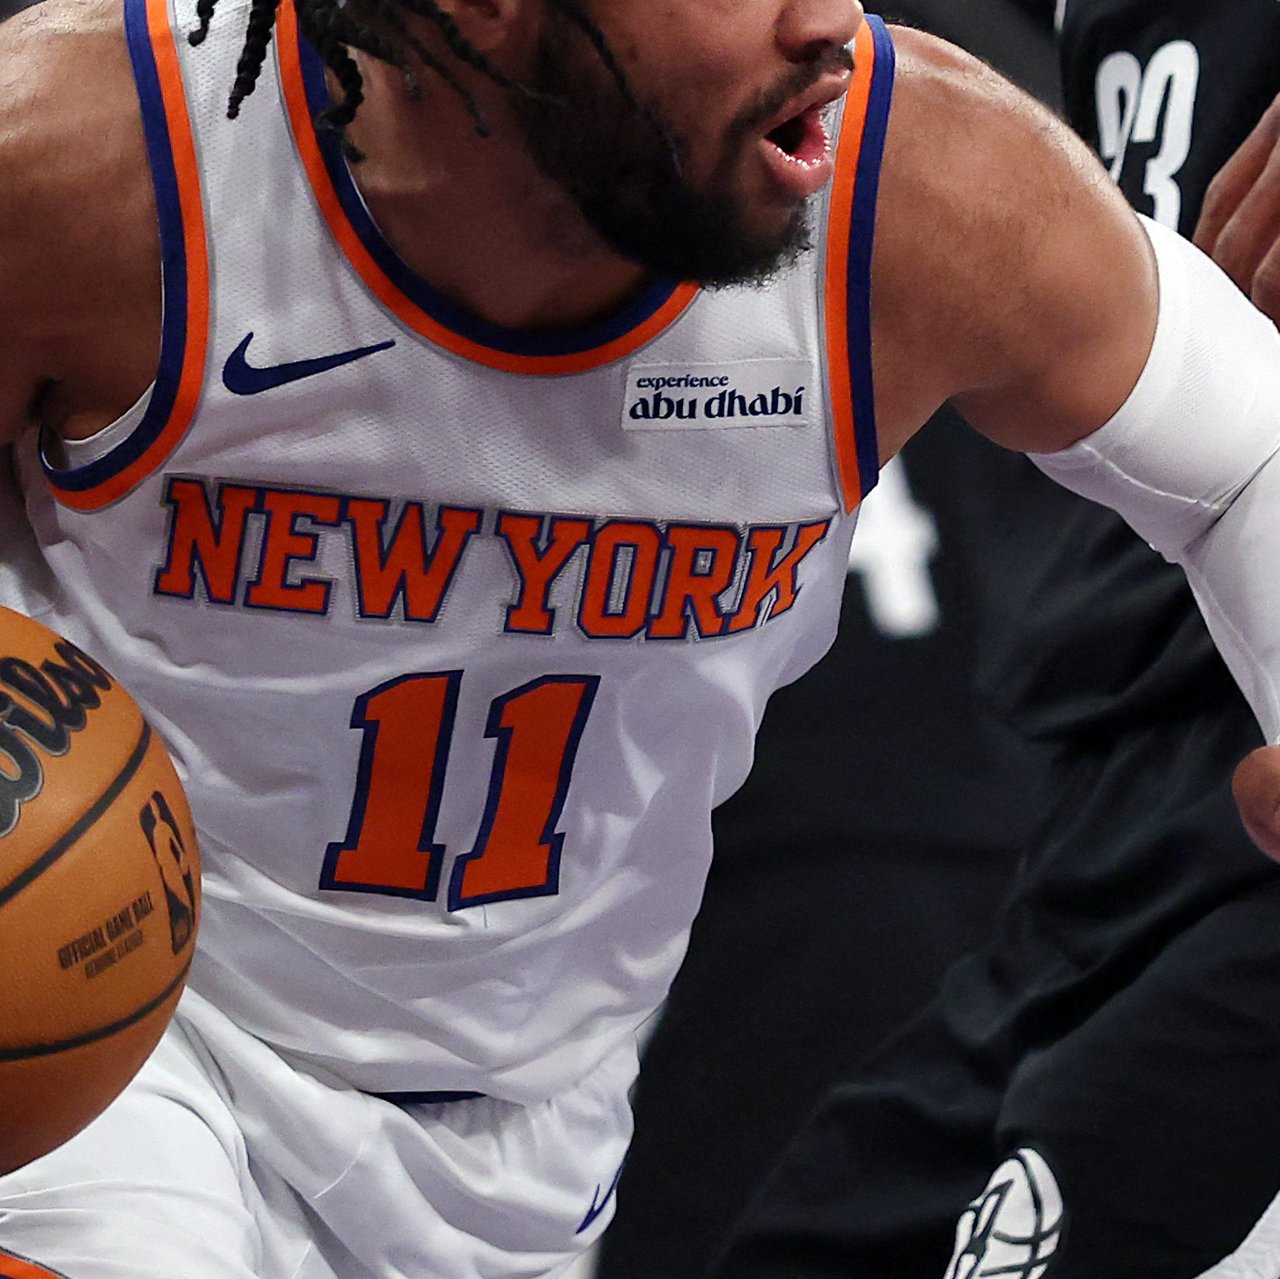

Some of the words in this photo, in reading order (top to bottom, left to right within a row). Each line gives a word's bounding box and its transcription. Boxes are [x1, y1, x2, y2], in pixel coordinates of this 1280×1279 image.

[629, 391, 697, 419] abu
[704, 386, 805, 418] dhabi
[636, 374, 729, 391] experience
[153, 475, 480, 623] NEW
[493, 514, 830, 641] YORK
[319, 670, 601, 912] 11
